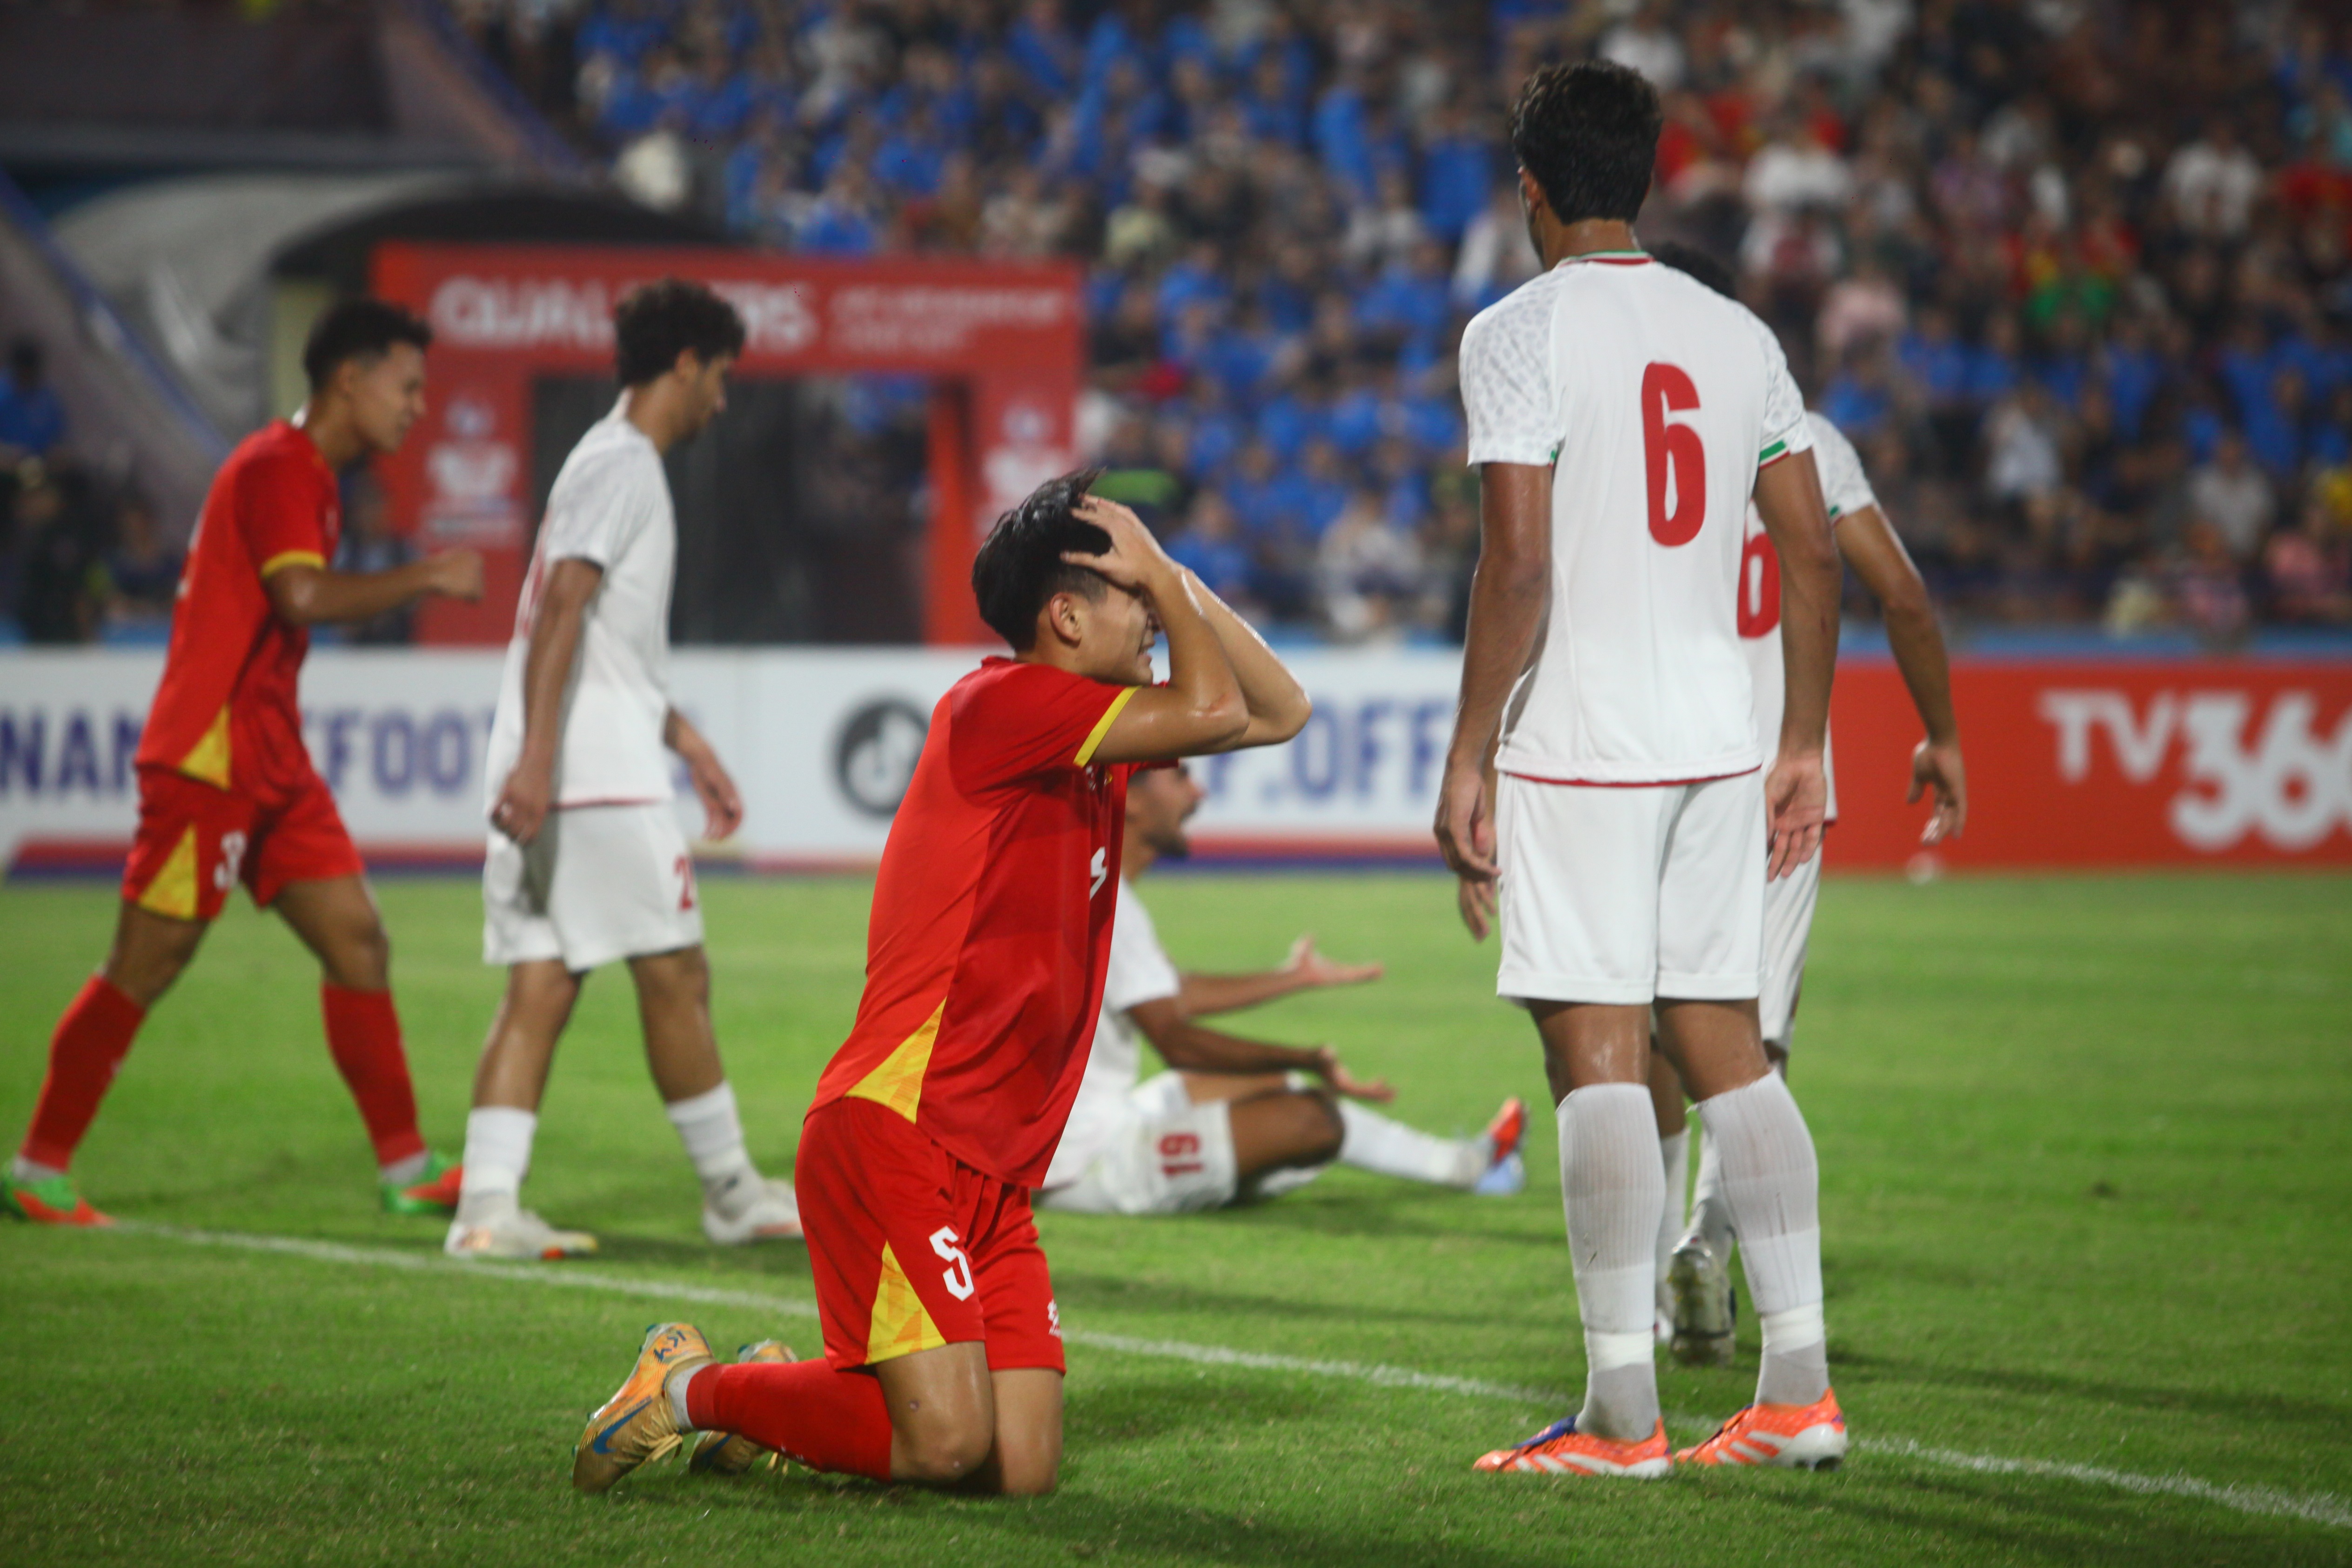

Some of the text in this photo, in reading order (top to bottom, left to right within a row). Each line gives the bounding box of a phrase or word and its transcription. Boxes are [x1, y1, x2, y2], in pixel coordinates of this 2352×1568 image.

[1641, 360, 1706, 548] 6
[1159, 1133, 1203, 1178] 19
[929, 1225, 974, 1301] 5
